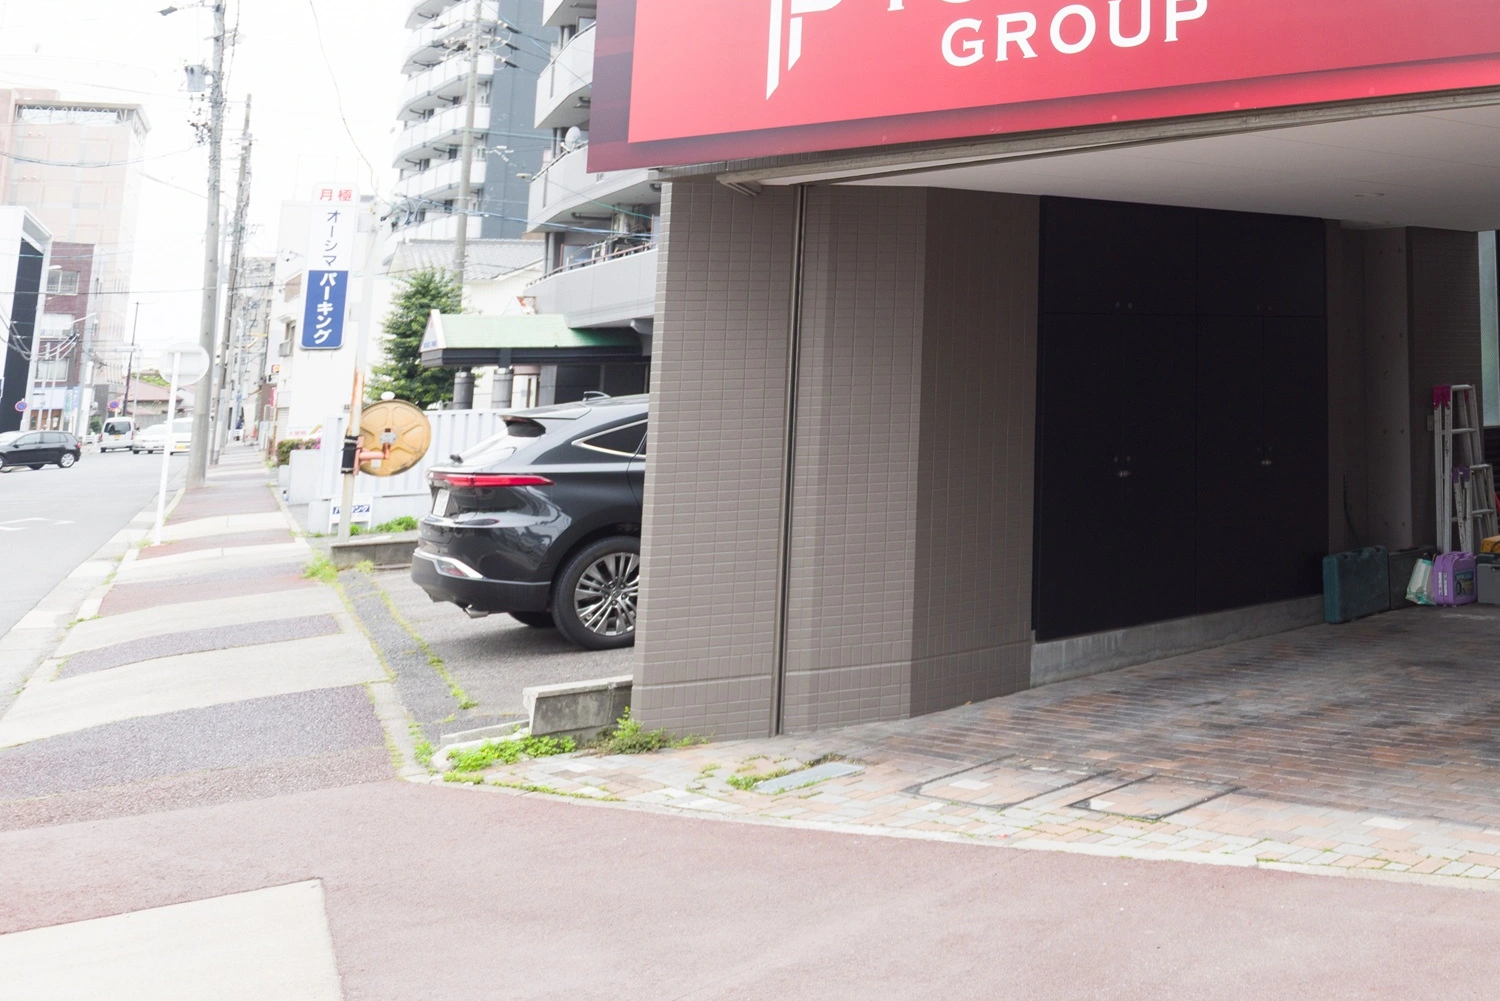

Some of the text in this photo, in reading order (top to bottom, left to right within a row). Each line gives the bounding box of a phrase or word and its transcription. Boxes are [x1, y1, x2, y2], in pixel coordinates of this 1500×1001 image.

[319, 188, 353, 201] 月極
[322, 209, 341, 267] オーシマ
[313, 271, 338, 345] パーキング
